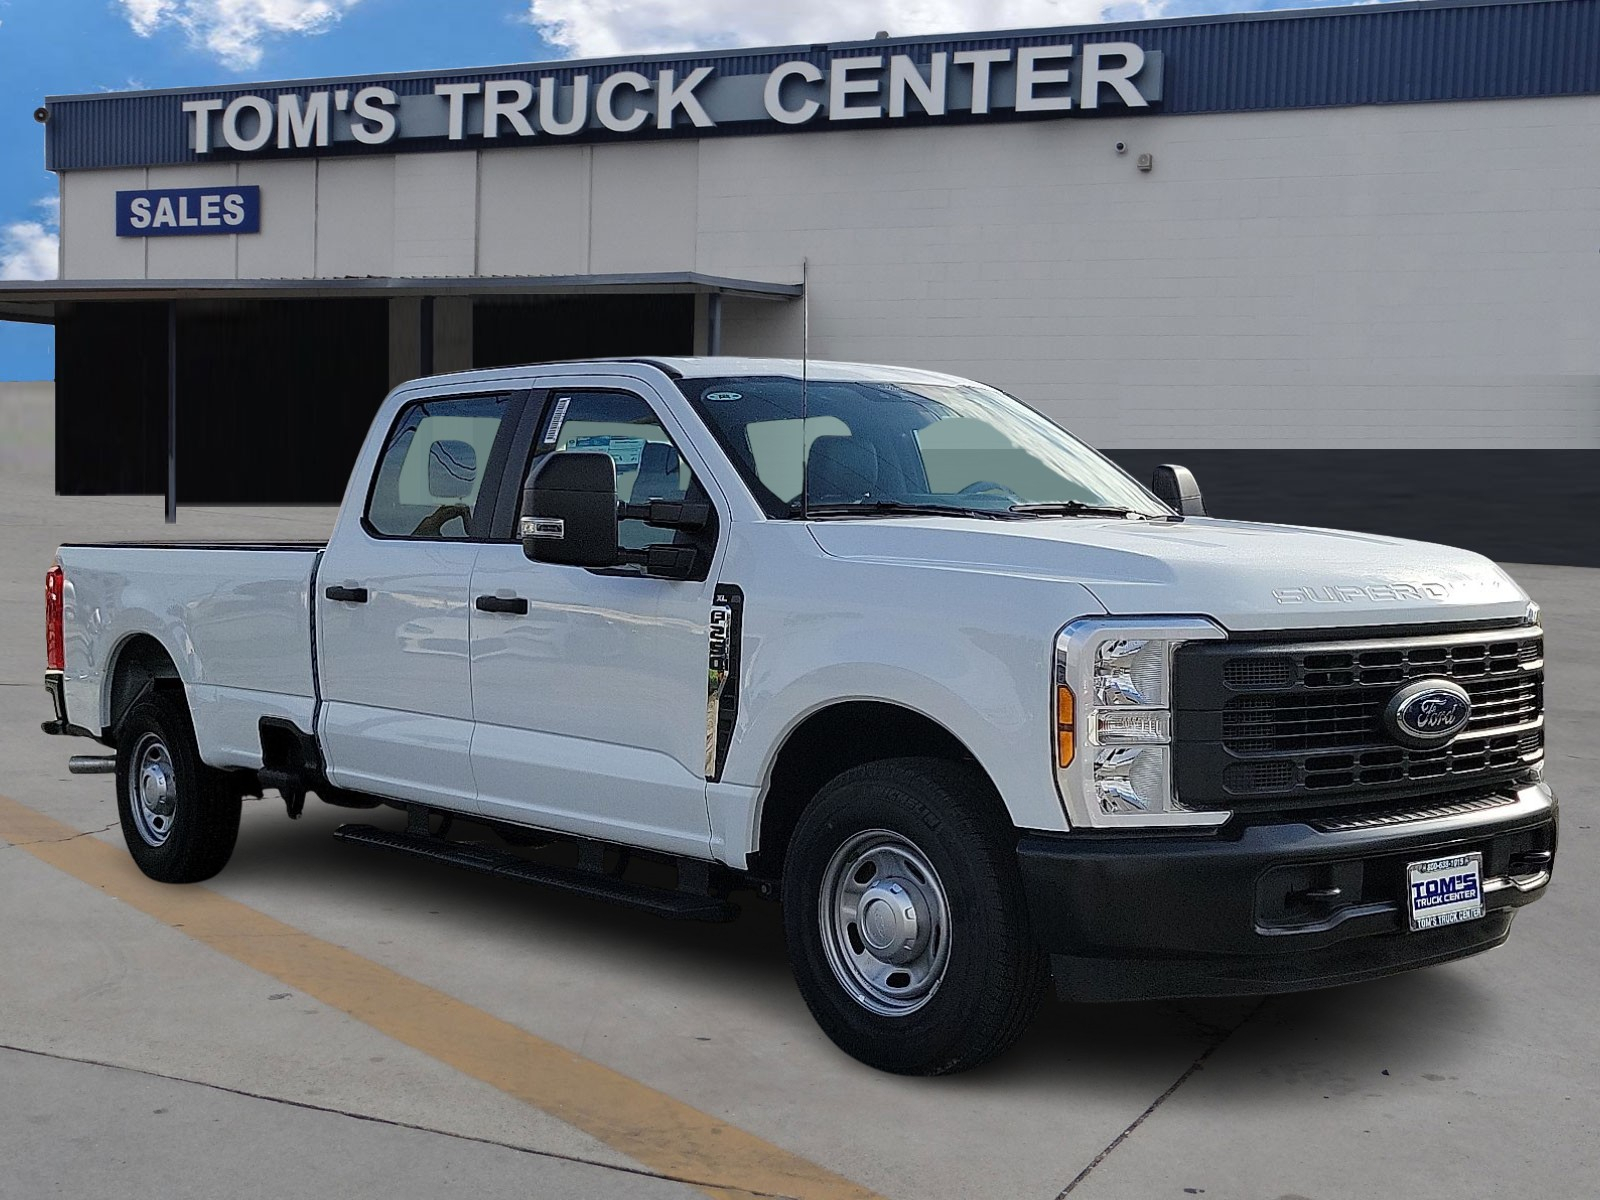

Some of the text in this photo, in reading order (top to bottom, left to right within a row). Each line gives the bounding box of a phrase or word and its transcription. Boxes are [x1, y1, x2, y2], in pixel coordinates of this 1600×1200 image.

[182, 41, 1149, 154] TOM'S TRUCK CENTER
[130, 194, 245, 228] SALES
[716, 594, 727, 602] XL
[1417, 699, 1458, 728] Ford
[1412, 873, 1477, 899] TOM'S
[1416, 889, 1476, 907] TRUCK CENTER
[1417, 907, 1481, 929] TOM'S TRUCK CENTER
